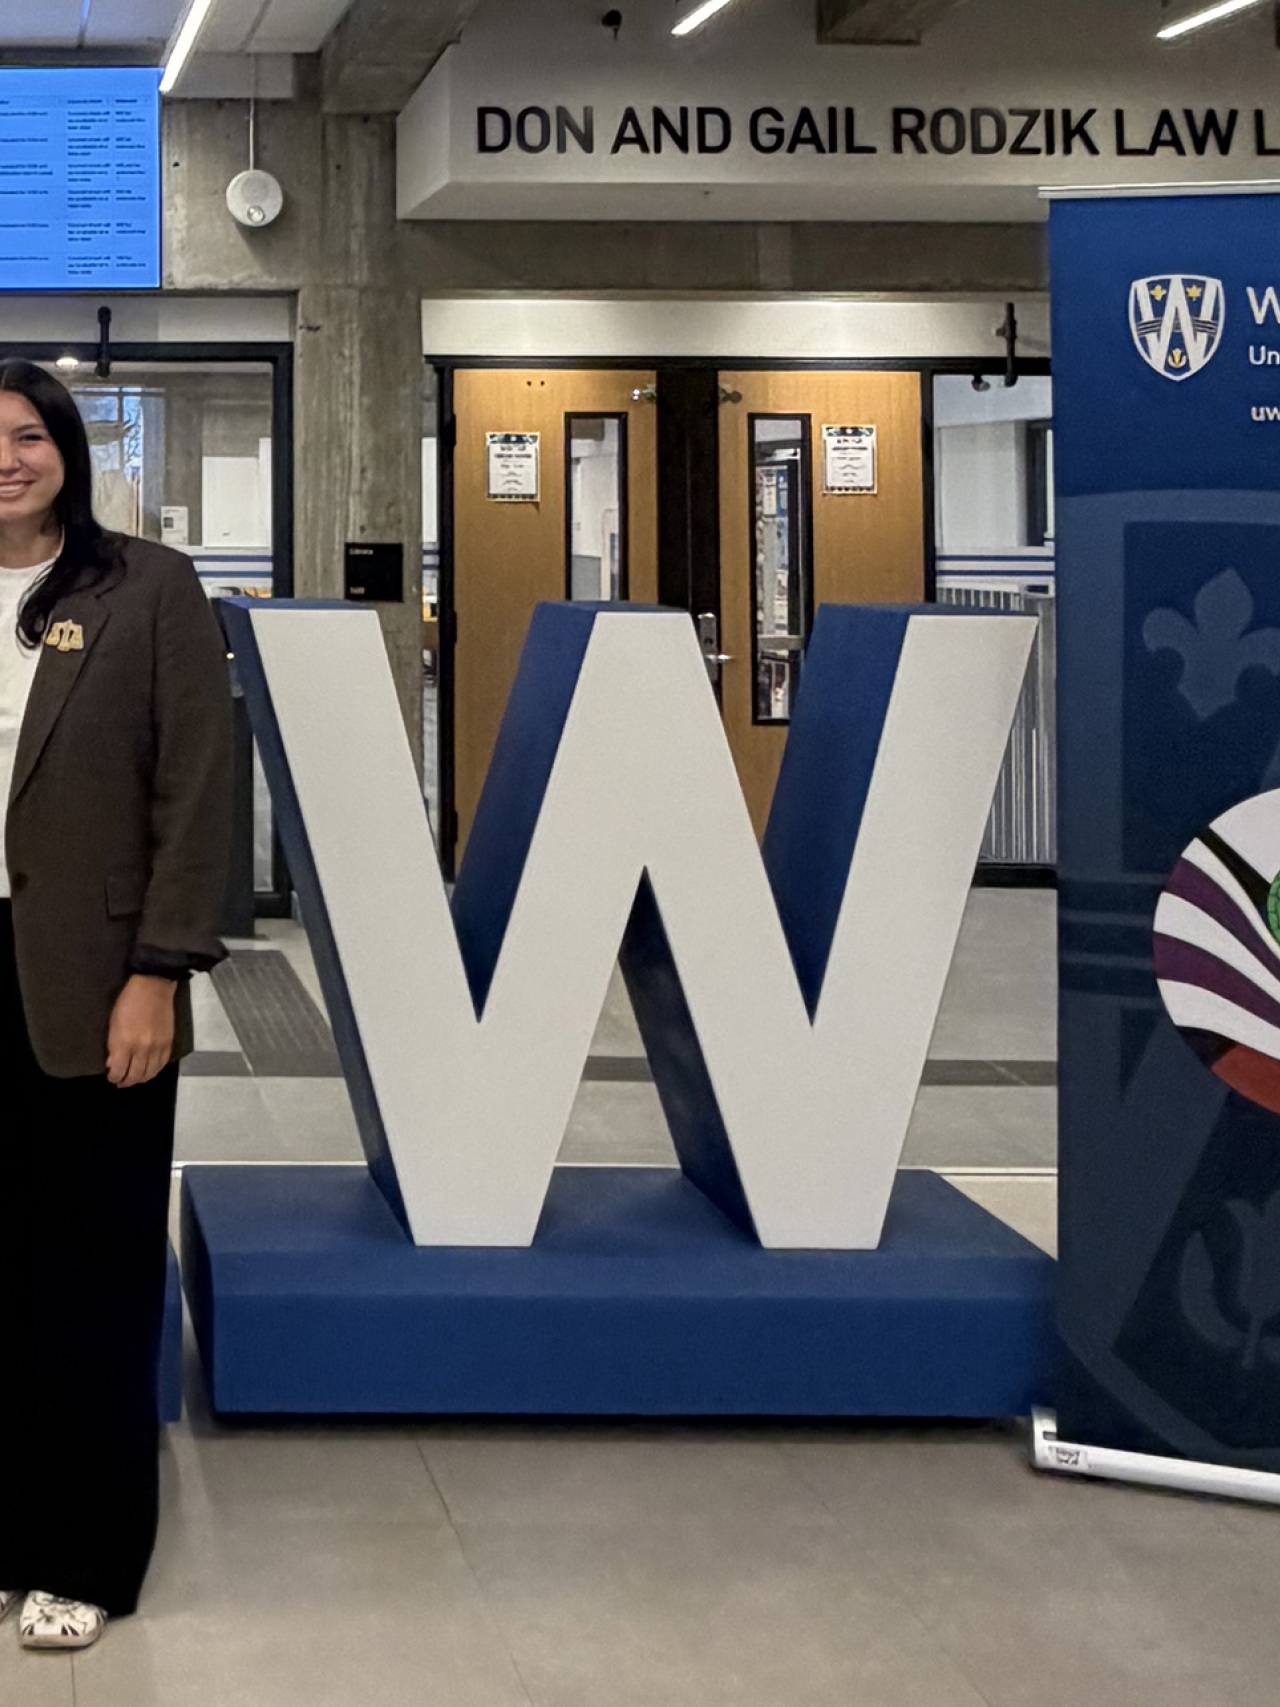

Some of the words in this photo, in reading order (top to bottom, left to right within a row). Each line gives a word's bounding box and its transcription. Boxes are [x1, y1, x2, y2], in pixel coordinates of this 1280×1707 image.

[476, 105, 594, 154] DON
[610, 105, 732, 154] AND
[748, 105, 878, 155] GAIL
[890, 106, 1100, 156] RODZIK
[1114, 107, 1239, 157] LAW
[1253, 107, 1280, 157] L
[1246, 286, 1280, 325] W
